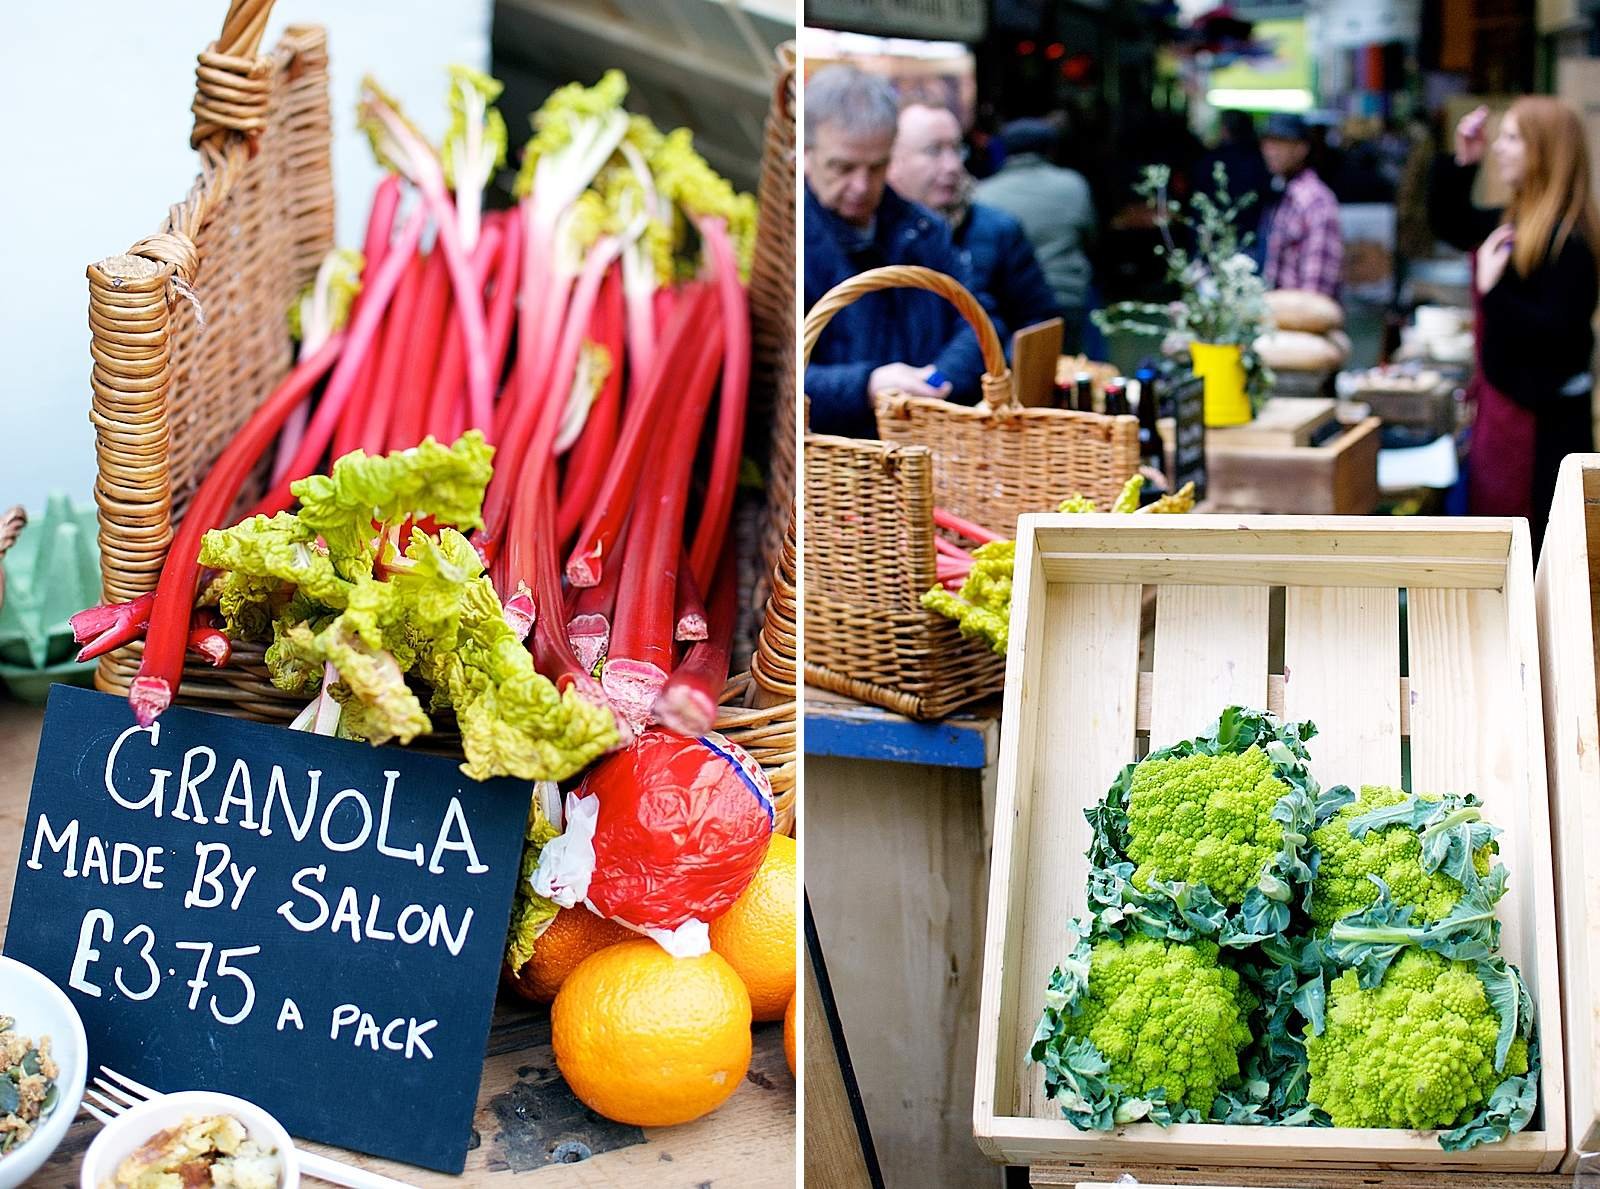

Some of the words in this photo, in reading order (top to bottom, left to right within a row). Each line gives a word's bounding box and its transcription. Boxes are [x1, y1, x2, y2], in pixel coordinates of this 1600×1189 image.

[104, 721, 490, 875] GRANOLA
[26, 813, 166, 890] MADE
[184, 841, 257, 911] BY
[276, 864, 475, 957] SALON
[69, 908, 262, 1025] £3.75
[276, 998, 304, 1031] A
[330, 1003, 439, 1060] PACK
